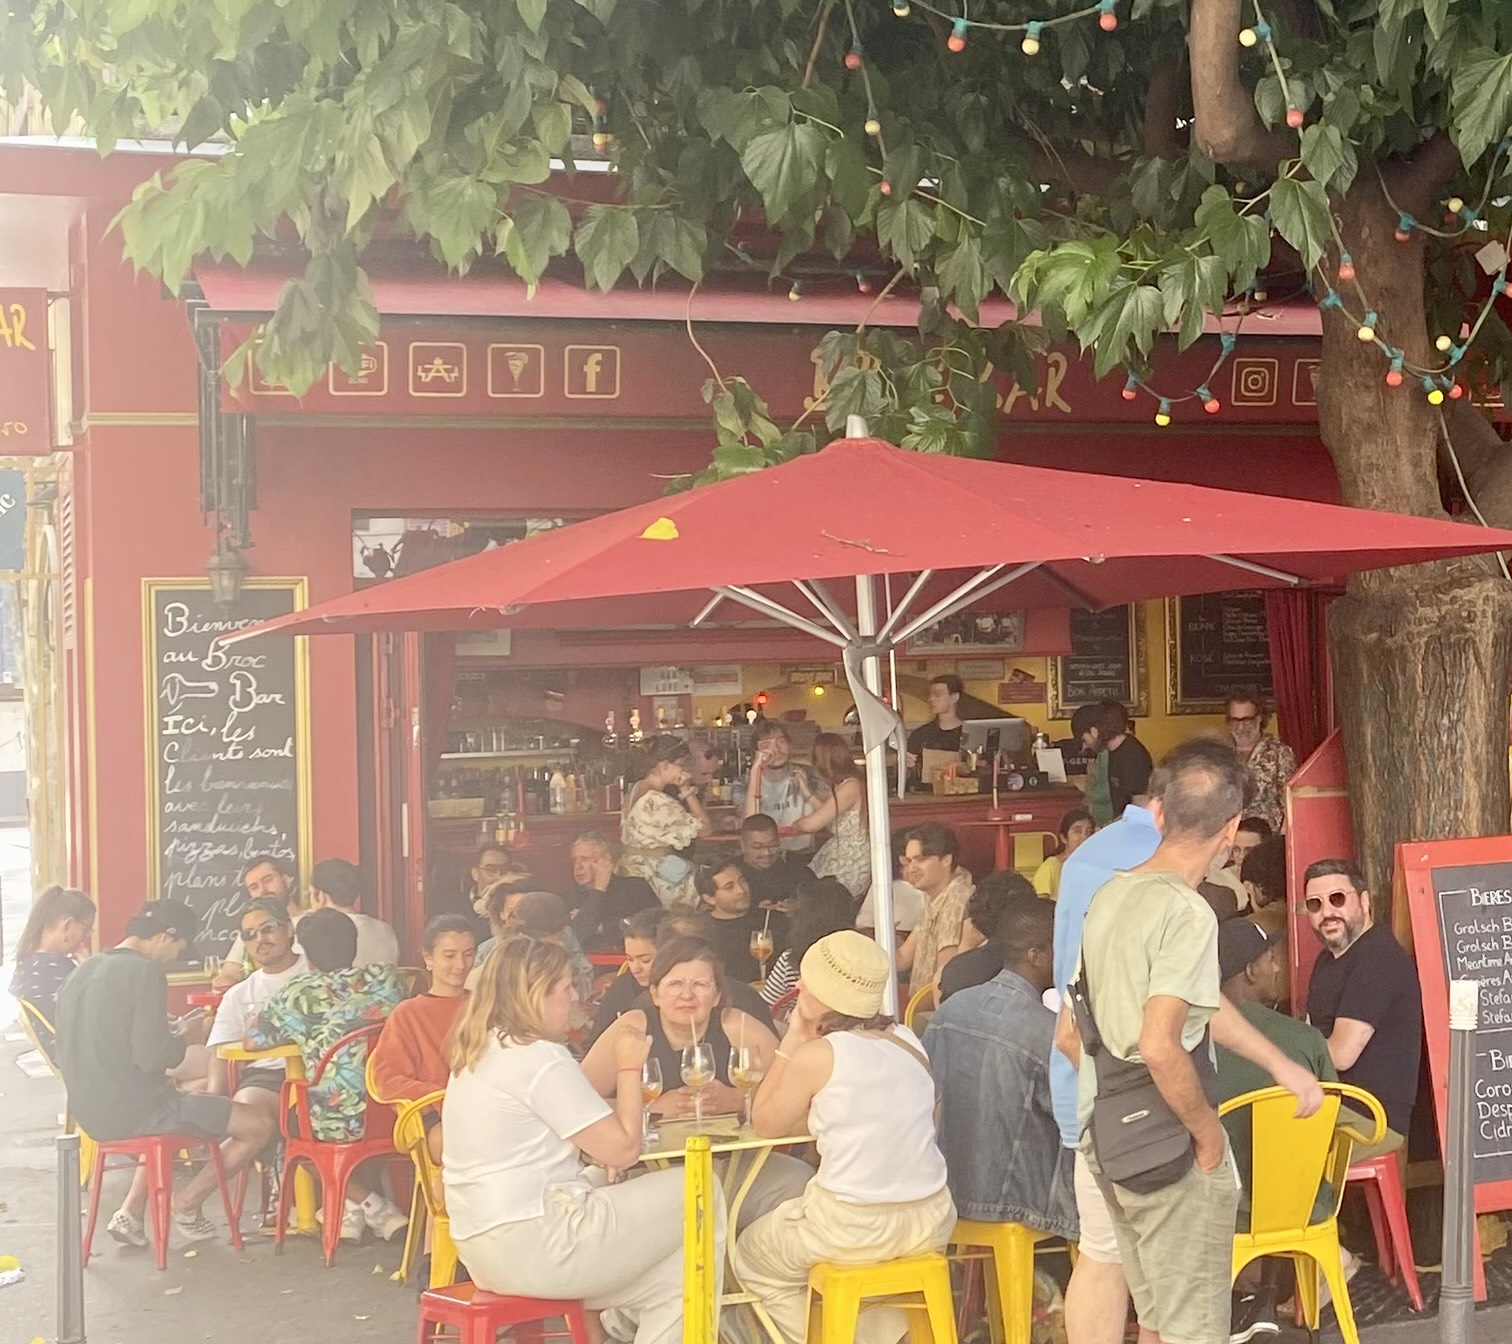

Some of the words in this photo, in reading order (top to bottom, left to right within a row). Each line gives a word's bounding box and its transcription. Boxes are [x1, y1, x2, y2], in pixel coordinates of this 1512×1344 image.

[163, 650, 199, 663] au
[201, 636, 267, 671] Broc
[228, 671, 285, 712] Bar
[220, 711, 256, 742] les
[249, 737, 294, 759] sont
[164, 765, 192, 794] les
[1470, 888, 1512, 906] BIERES
[1454, 918, 1500, 935] Grolsch
[1456, 936, 1500, 953] Grolsch
